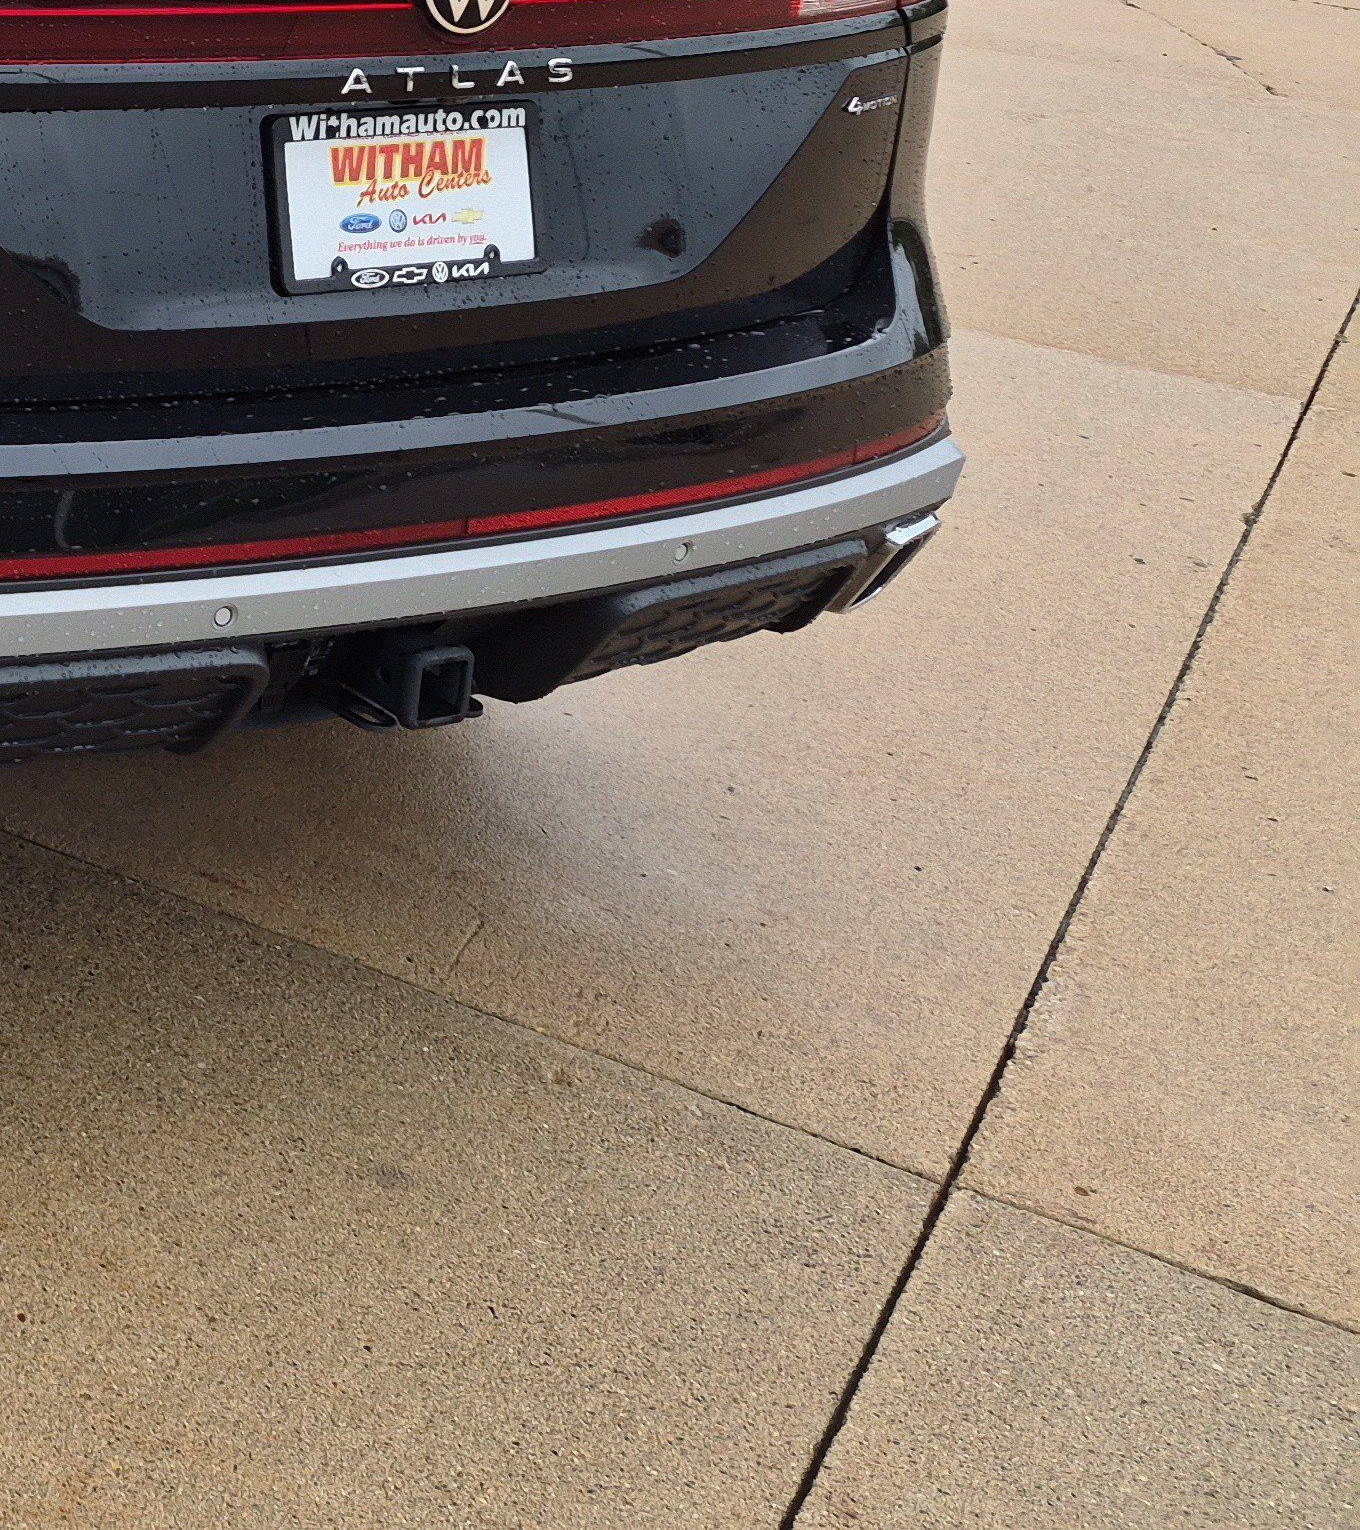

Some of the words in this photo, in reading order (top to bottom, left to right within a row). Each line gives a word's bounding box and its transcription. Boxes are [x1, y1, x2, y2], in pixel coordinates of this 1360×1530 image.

[341, 58, 573, 94] ATLAS
[331, 137, 484, 182] WITHAM
[357, 178, 410, 207] Auto
[418, 167, 492, 198] Centers
[345, 216, 376, 231] Ford
[337, 239, 388, 253] Everything
[390, 239, 402, 248] we
[404, 237, 416, 248] do
[417, 236, 425, 246] is
[427, 235, 456, 246] driven
[457, 233, 467, 245] by
